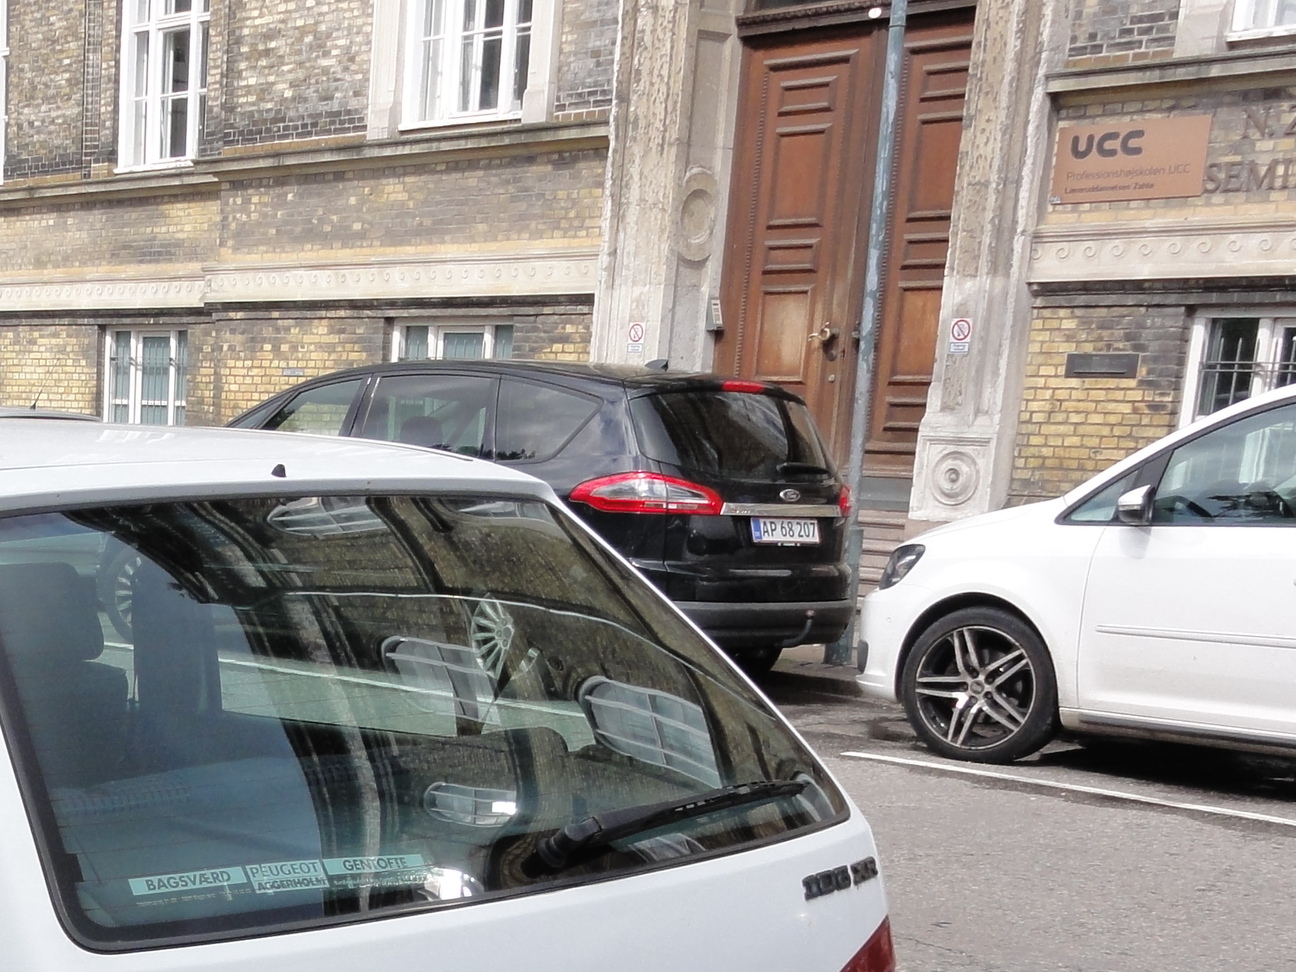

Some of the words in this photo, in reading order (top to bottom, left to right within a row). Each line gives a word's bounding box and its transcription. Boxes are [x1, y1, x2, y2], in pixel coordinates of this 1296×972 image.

[1070, 129, 1146, 160] UCC
[1168, 163, 1192, 175] UCC
[762, 520, 777, 538] AP
[780, 520, 795, 538] 68
[796, 521, 816, 539] 207
[249, 861, 319, 879] PEUGEOT
[343, 856, 408, 872] GENTOFTE
[145, 870, 232, 892] BAGSVÆRD
